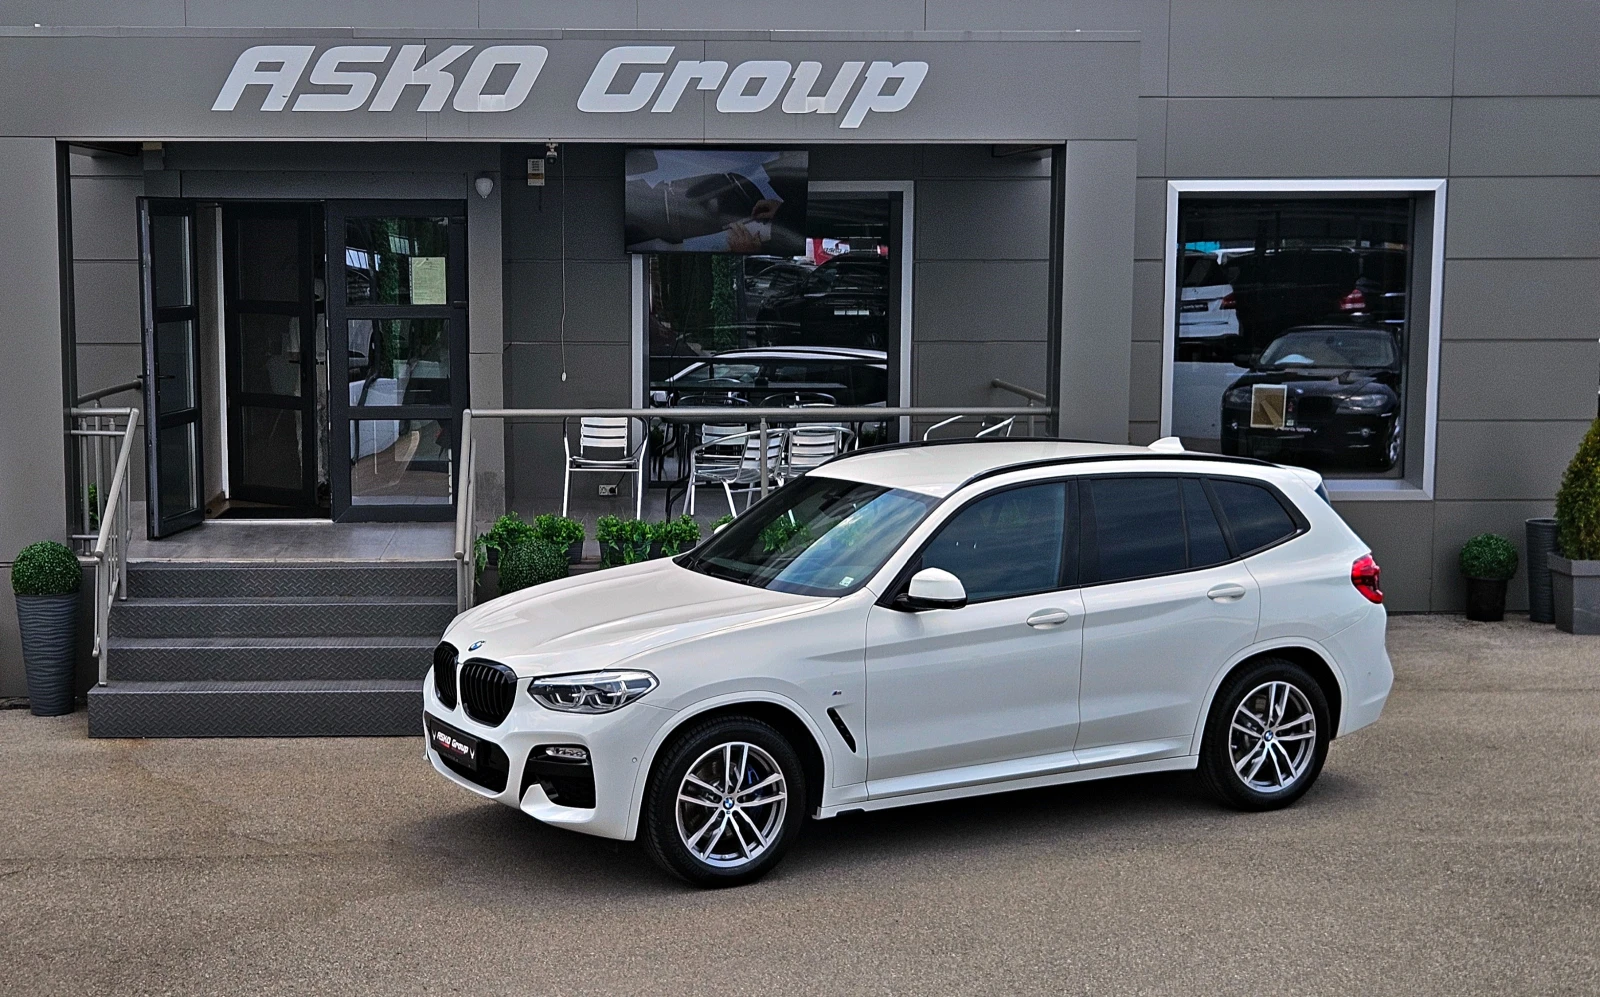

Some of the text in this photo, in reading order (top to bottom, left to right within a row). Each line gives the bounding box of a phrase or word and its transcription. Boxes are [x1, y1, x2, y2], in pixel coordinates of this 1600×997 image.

[211, 45, 928, 128] ASKO Group
[437, 731, 469, 754] ASKO Group
